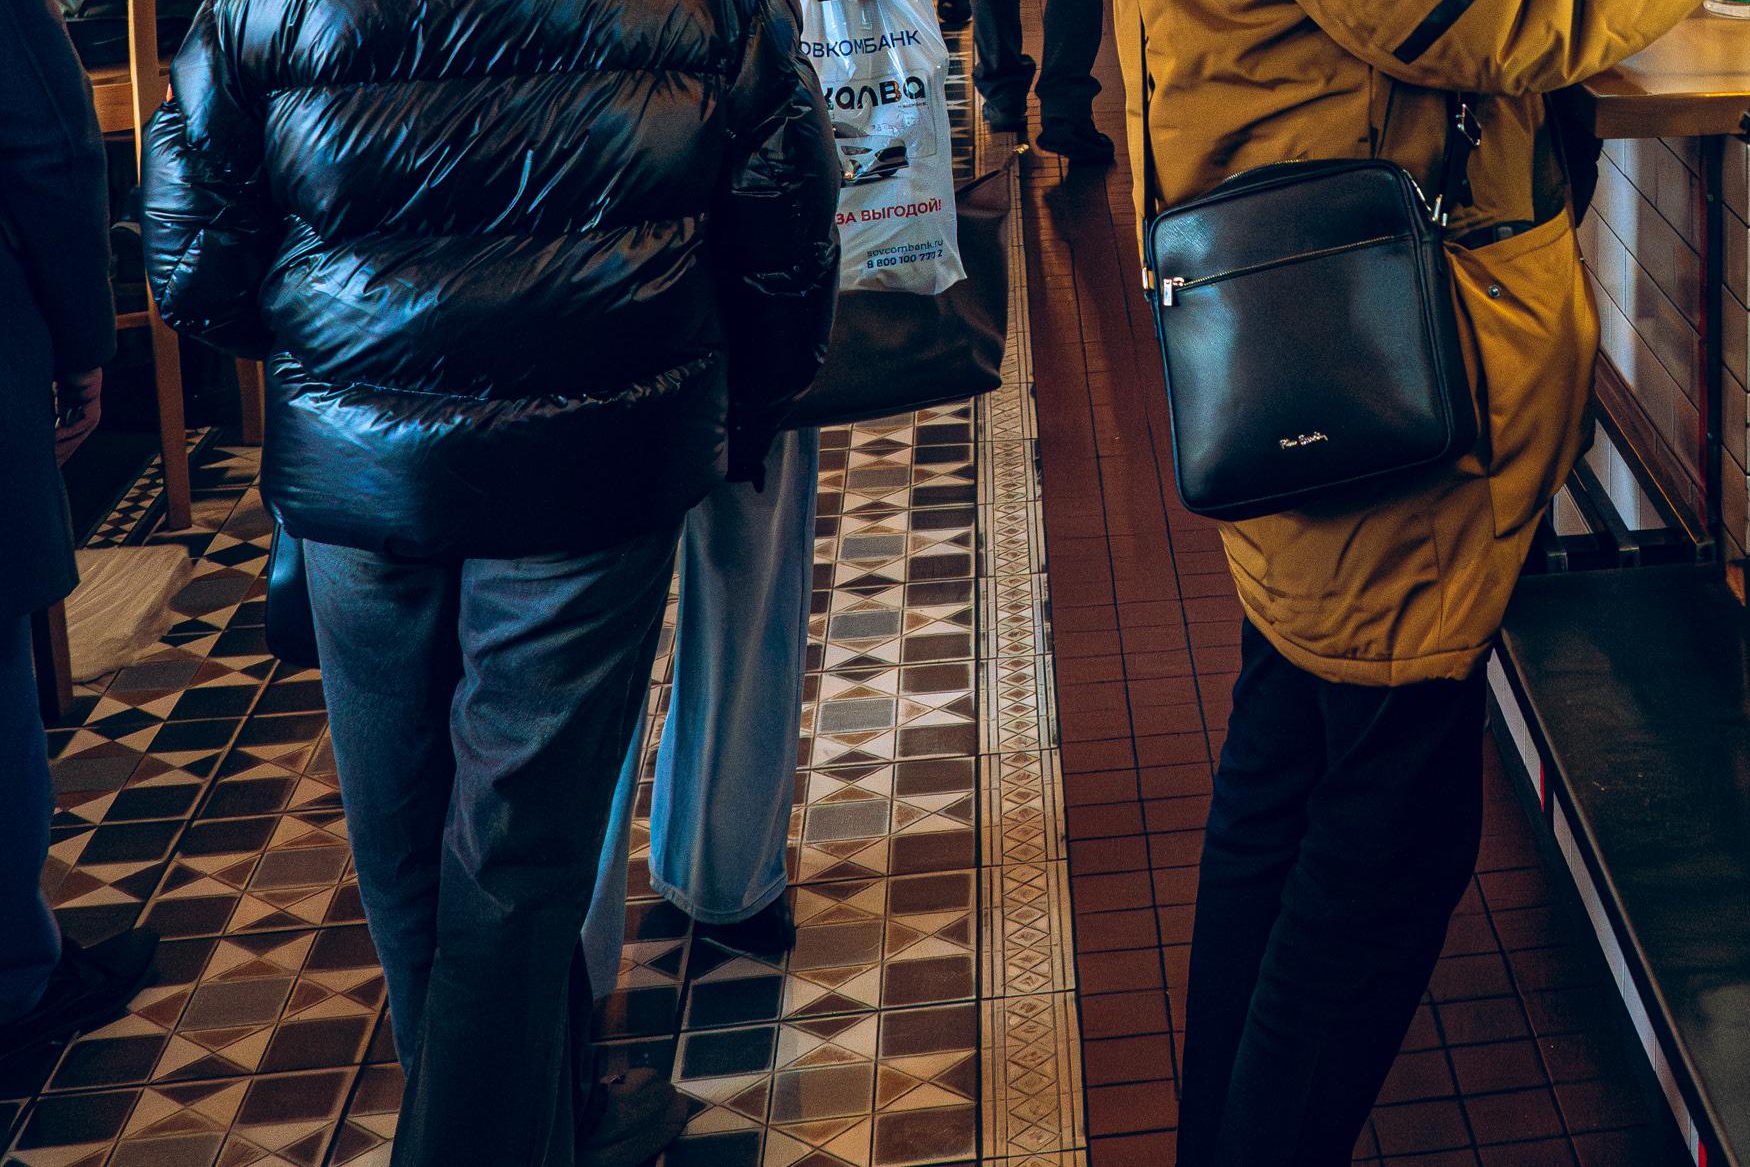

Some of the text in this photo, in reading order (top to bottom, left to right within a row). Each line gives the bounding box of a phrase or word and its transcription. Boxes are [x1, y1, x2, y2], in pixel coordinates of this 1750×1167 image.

[801, 29, 922, 58] ОВКОМБАНК
[836, 197, 942, 226] ЗА ВЫГОДОЙ!
[867, 239, 944, 257] sovcombank.ru
[867, 260, 874, 269] 8
[876, 256, 897, 268] 800
[899, 254, 917, 265] 100
